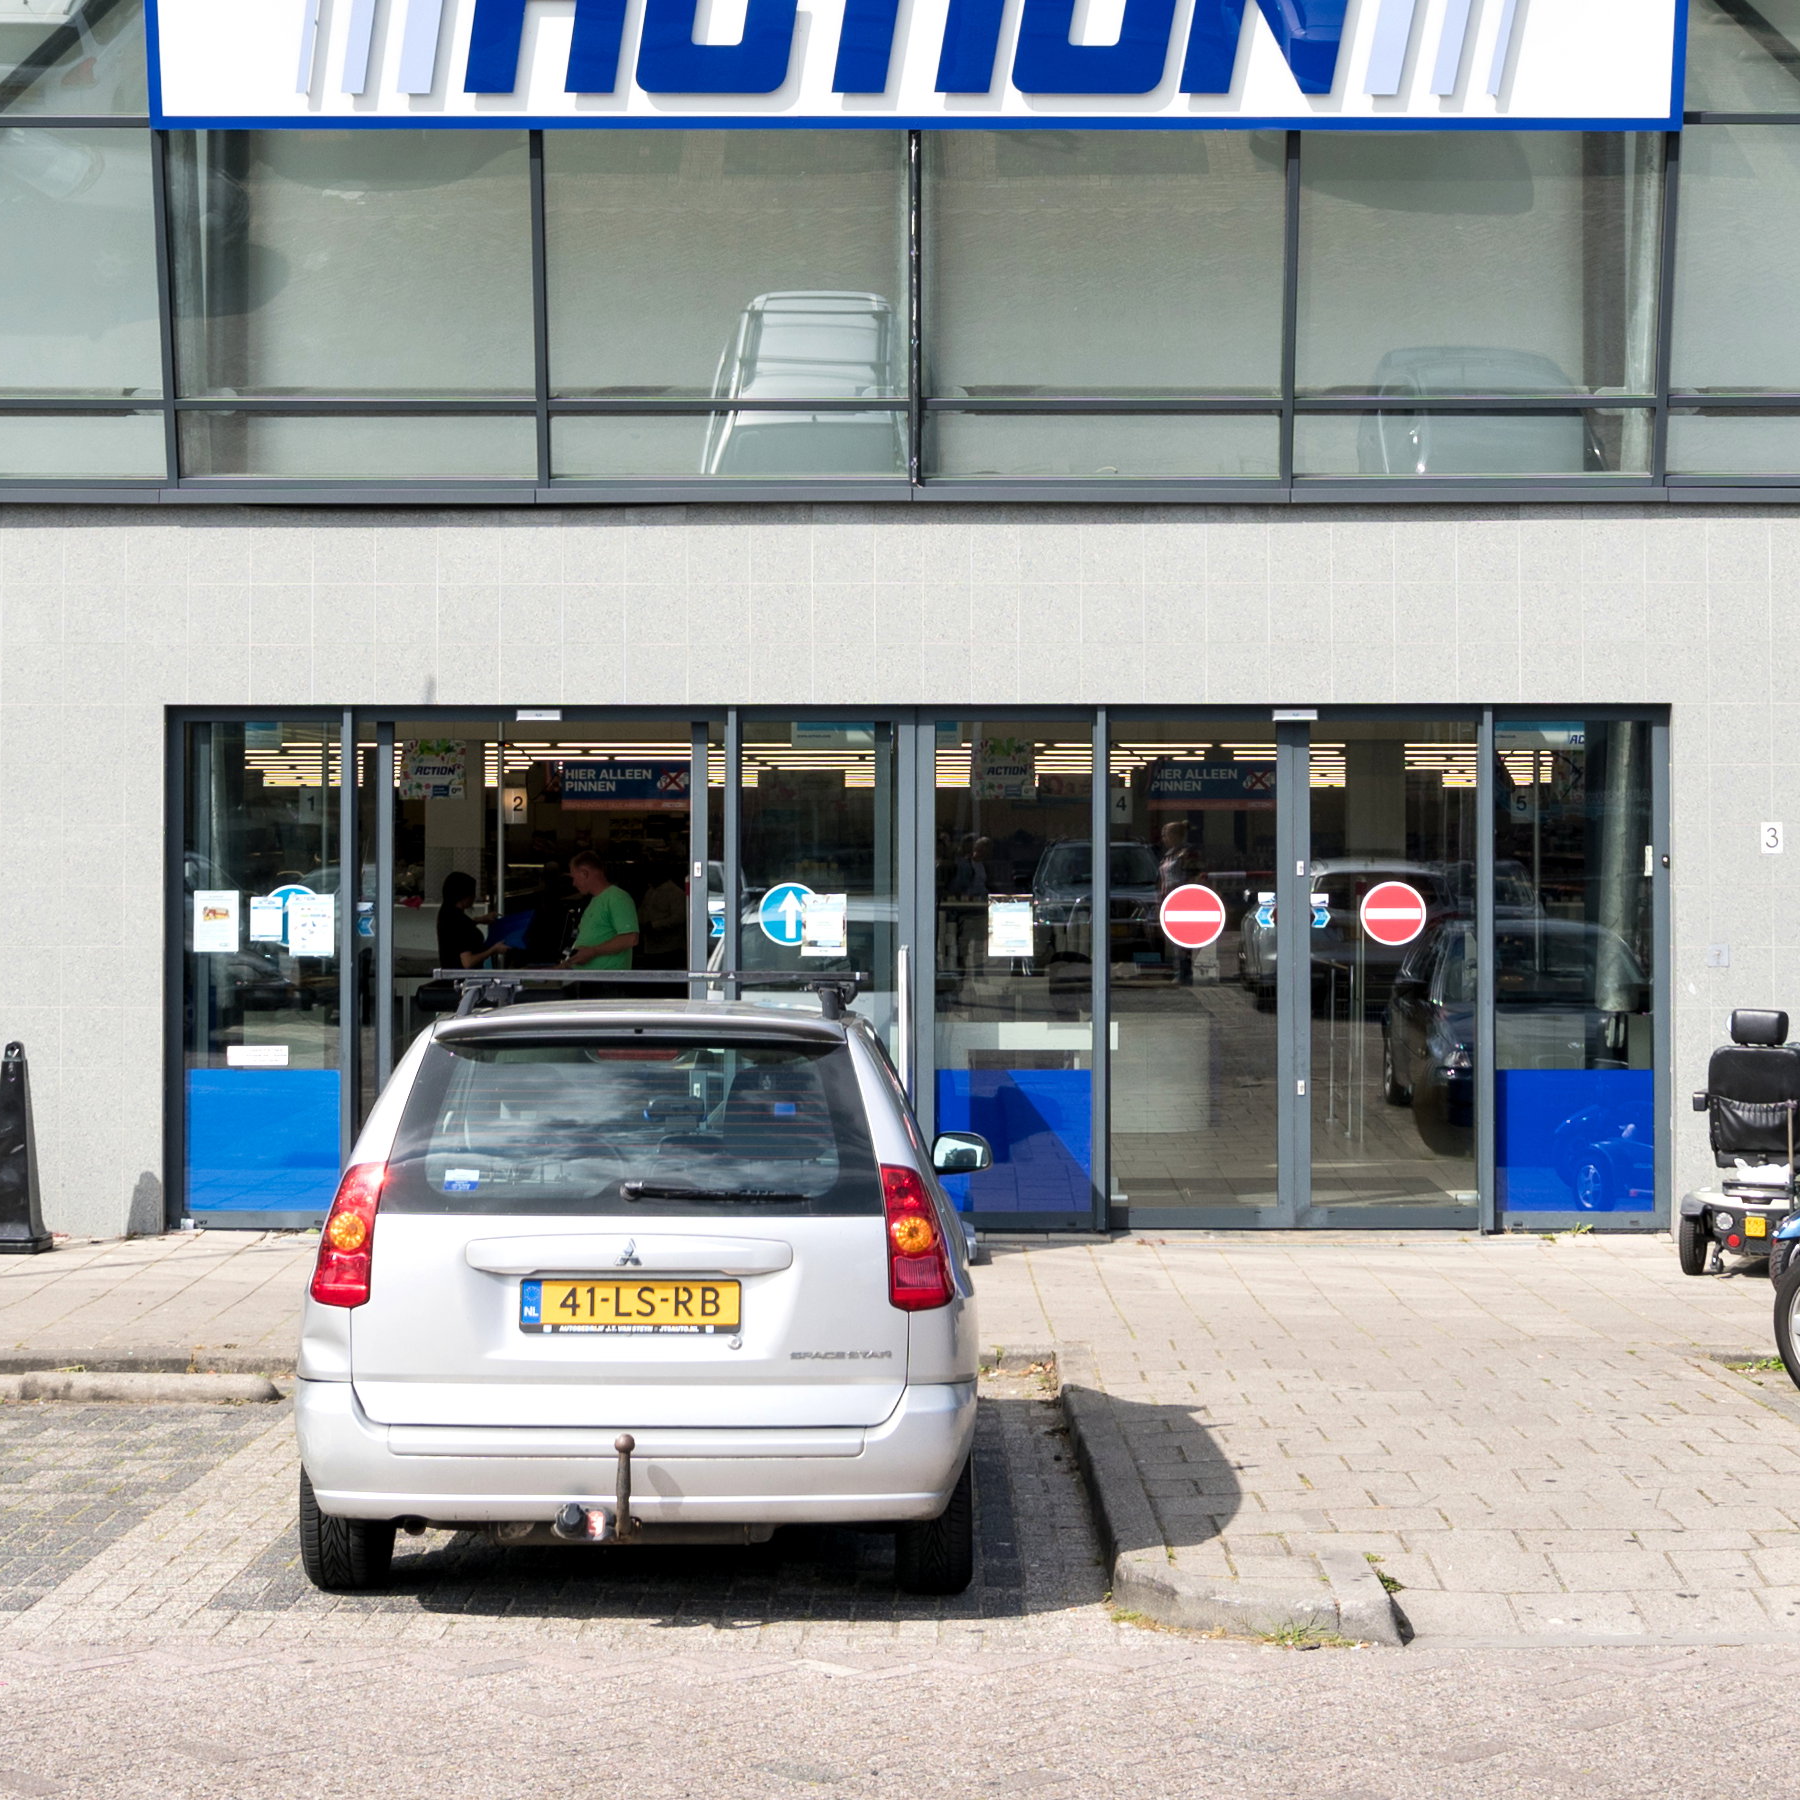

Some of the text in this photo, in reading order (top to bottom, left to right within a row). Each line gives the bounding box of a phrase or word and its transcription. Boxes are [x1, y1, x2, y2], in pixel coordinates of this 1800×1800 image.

[414, 765, 456, 776] ACTION
[564, 768, 653, 780] HIER ALLEEN
[986, 766, 1027, 776] ACTION
[1185, 768, 1238, 780] ALLEEN
[564, 781, 616, 792] PINNEN
[1151, 781, 1202, 792] PINNEN
[512, 795, 524, 812] 2
[1115, 795, 1127, 812] 4
[1516, 795, 1528, 812] 5
[1765, 827, 1779, 849] 3
[559, 1286, 721, 1317] 41-LS-RB
[524, 1306, 539, 1317] NL
